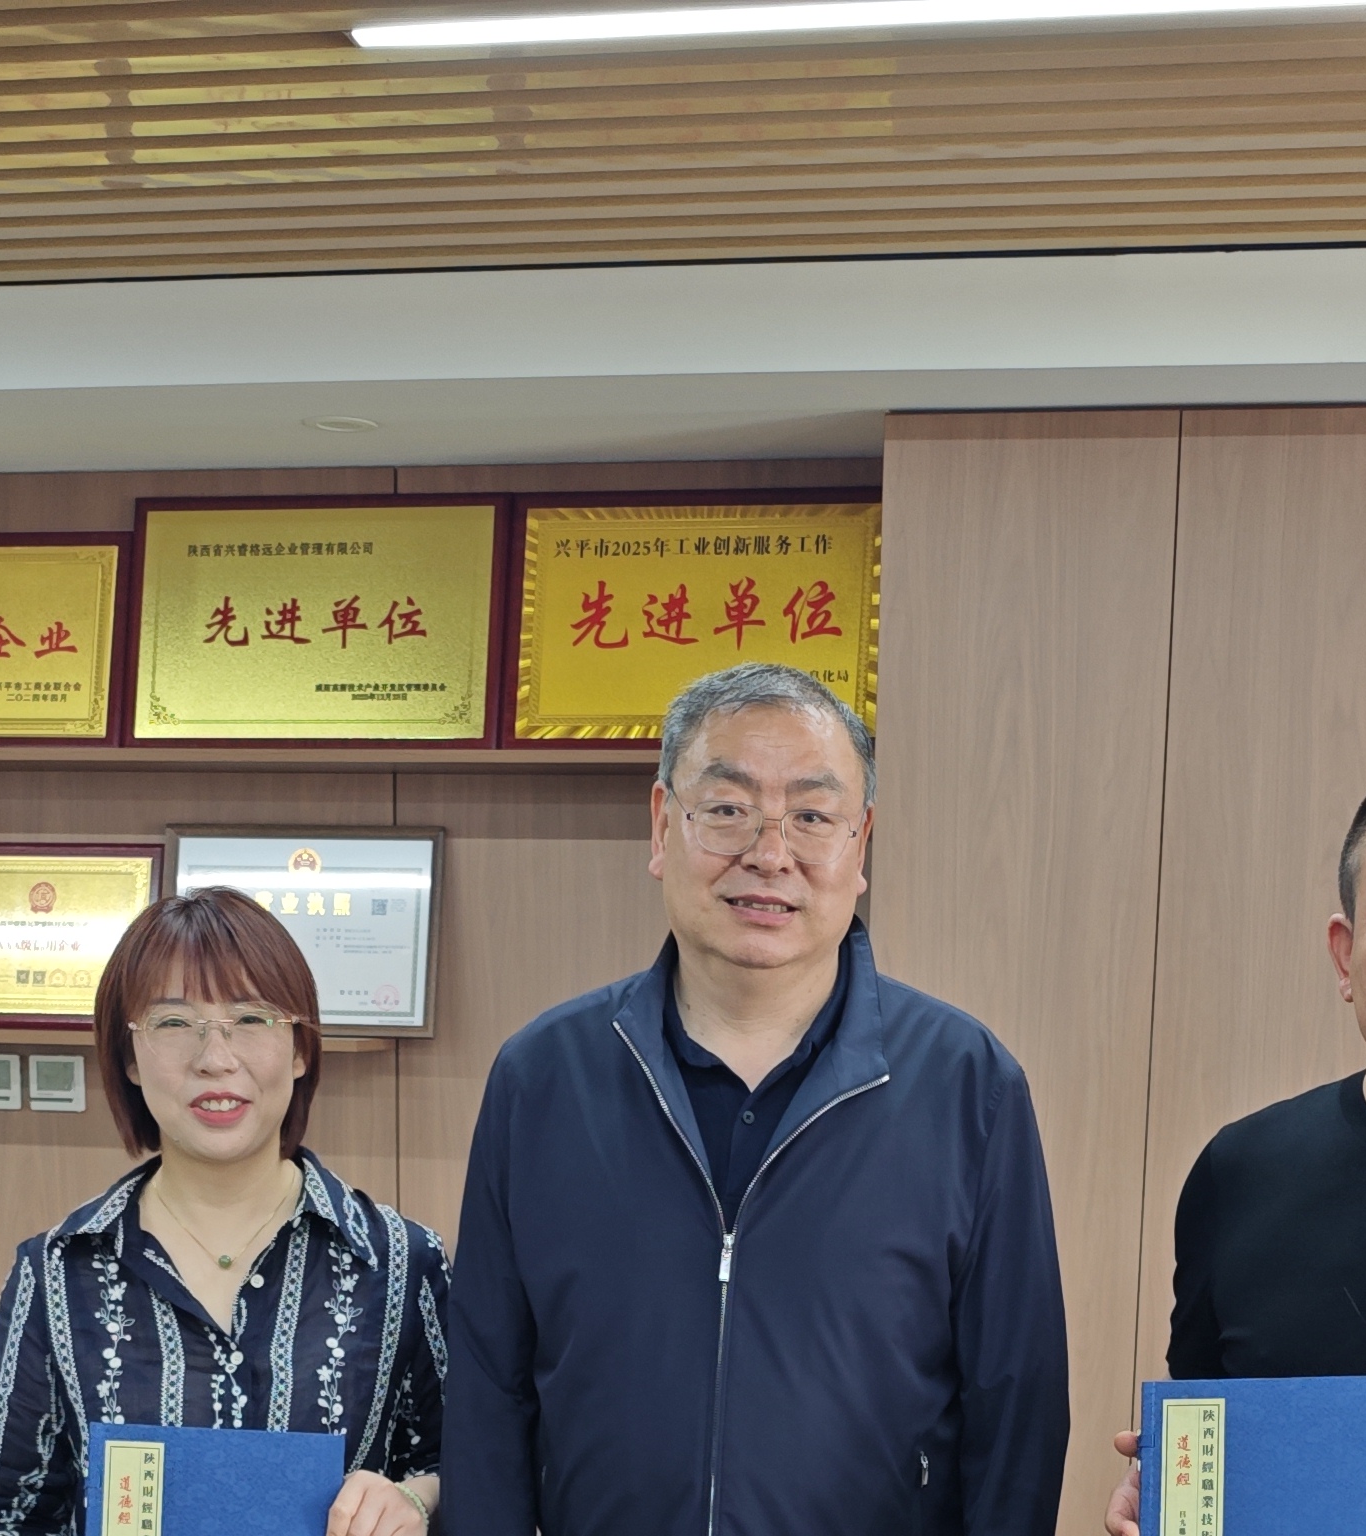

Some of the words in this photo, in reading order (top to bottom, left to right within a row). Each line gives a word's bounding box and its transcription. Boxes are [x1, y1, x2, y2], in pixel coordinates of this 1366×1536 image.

[553, 534, 833, 559] 兴平市2025年工业创新服务工作
[204, 596, 429, 649] 先进单位
[569, 576, 843, 651] 先进单位
